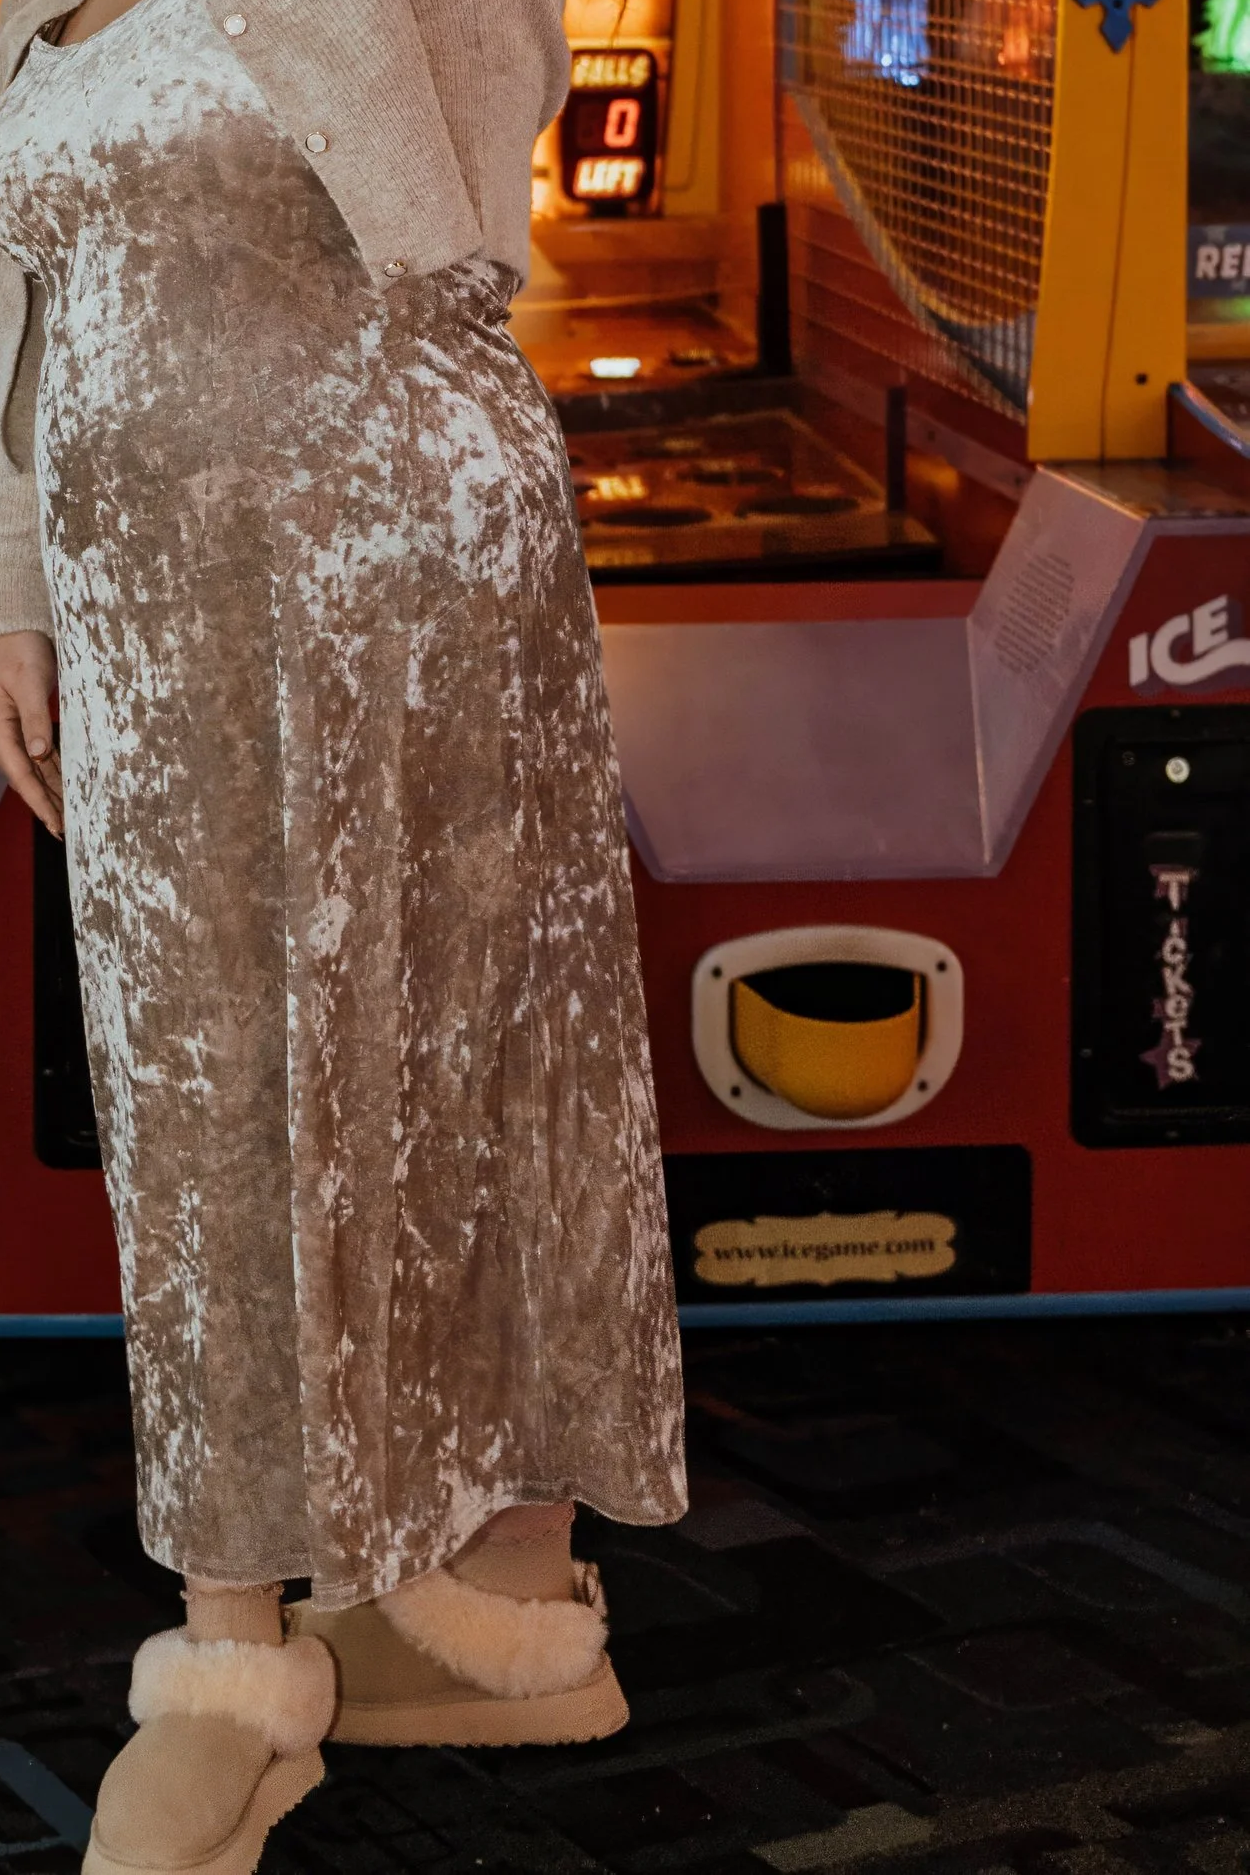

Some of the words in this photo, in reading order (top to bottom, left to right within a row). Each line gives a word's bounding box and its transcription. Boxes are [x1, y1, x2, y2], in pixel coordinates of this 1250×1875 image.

[604, 98, 640, 149] 0
[573, 156, 646, 198] LEFT
[1195, 242, 1250, 281] RE
[1129, 594, 1250, 687] ICE
[713, 1236, 936, 1262] www.icegame.com
